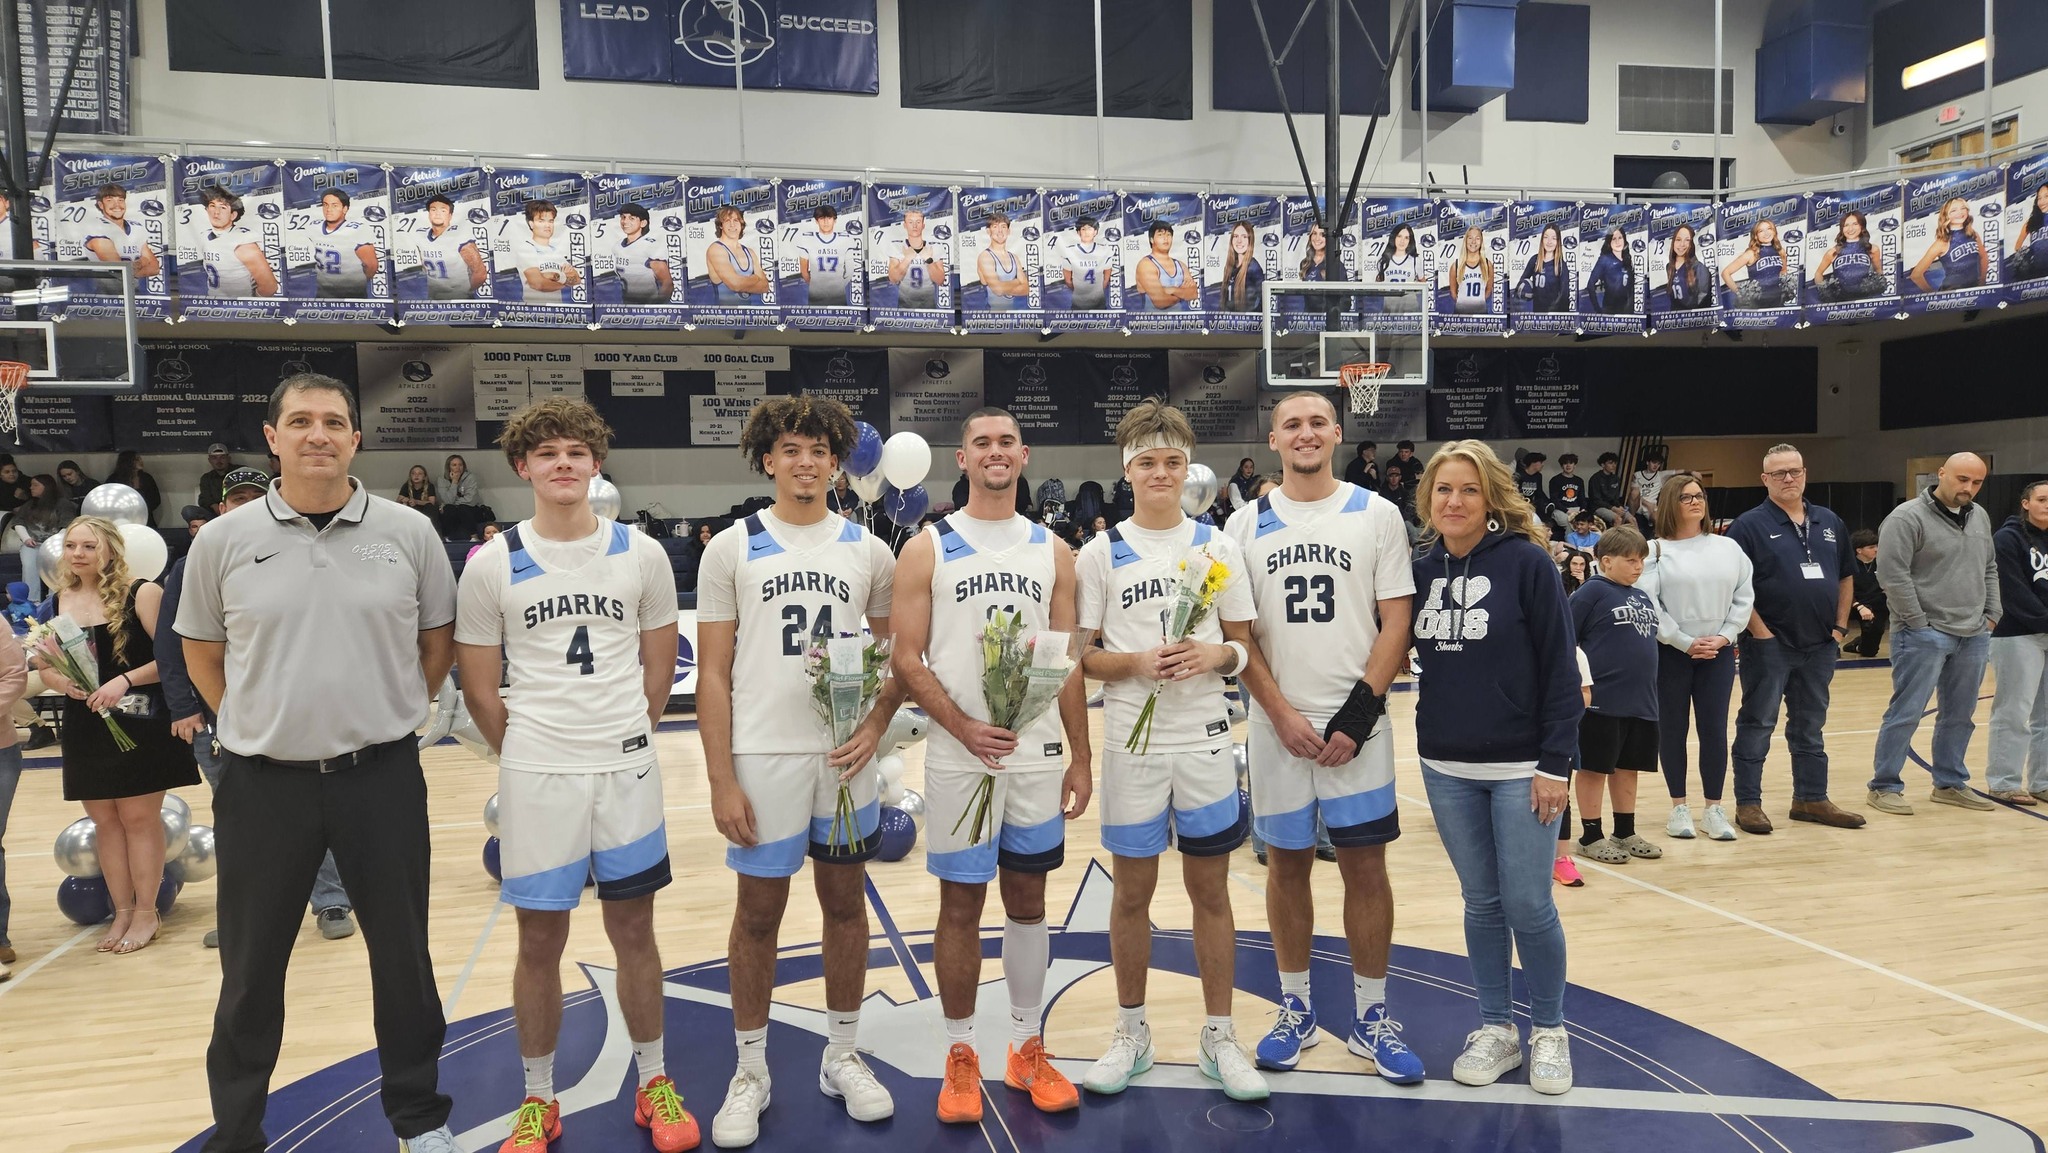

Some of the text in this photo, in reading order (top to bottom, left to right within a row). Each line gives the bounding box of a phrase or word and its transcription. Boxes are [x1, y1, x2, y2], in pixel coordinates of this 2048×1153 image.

[580, 3, 650, 22] LEAD
[779, 14, 874, 35] SUCCEED
[65, 159, 111, 172] Mason
[186, 161, 225, 176] Dallas
[62, 162, 148, 192] SARGIS
[182, 165, 268, 194] SCOTT
[294, 166, 326, 181] Jason
[402, 169, 442, 185] Adriel
[395, 171, 480, 203] RODRIGUEZ
[495, 175, 529, 189] Kaleb
[599, 178, 631, 192] Stefan
[496, 179, 585, 206] STENGEL
[595, 180, 675, 211] PUTZEYS
[688, 184, 724, 199] Chase
[787, 182, 825, 198] Jackson
[878, 187, 909, 200] Chuck
[1910, 170, 1998, 212] RICHARDSON
[688, 185, 771, 214] WILLIAMS
[785, 186, 852, 213] SABATH
[889, 193, 931, 213] SIPE
[960, 194, 988, 206] Ben
[1050, 194, 1080, 206] Kevin
[1126, 196, 1171, 213] Andrew
[1816, 196, 1840, 209] Ava
[1049, 196, 1115, 221] CISNEROS
[1141, 201, 1180, 223] UPP
[1216, 201, 1271, 225] BERGE
[1584, 207, 1609, 219] Emily
[1723, 198, 1797, 231] CAHOON
[1906, 229, 1927, 239] 2026
[60, 246, 82, 256] 2026
[1809, 240, 1828, 249] 2026
[179, 252, 198, 260] 2026
[289, 252, 311, 261] 2026
[396, 255, 417, 264] 2026
[1833, 254, 1871, 269] OHS
[594, 260, 614, 269] 2026
[781, 262, 800, 272] 2026
[817, 257, 838, 272] 17
[910, 267, 923, 288] 9
[1026, 244, 1041, 309] SHARKS
[1084, 269, 1096, 284] 4
[1493, 253, 1504, 313] SHARKS
[1535, 275, 1545, 287] 10
[1466, 282, 1481, 297] 10
[1672, 285, 1683, 299] 13
[1965, 289, 1996, 298] SCHOOL
[1926, 297, 1978, 311] DANCE
[183, 307, 288, 321] FOOTBALL
[294, 308, 392, 321] FOOTBALL
[402, 311, 498, 322] FOOTBALL
[499, 312, 589, 324] BASKETBALL
[599, 315, 687, 325] FOOTBALL
[693, 315, 779, 326] WRESTLING
[1827, 308, 1877, 321] DANCE
[784, 316, 866, 327] FOOTBALL
[874, 318, 952, 329] FOOTBALL
[965, 320, 1043, 329] WRESTLING
[1050, 320, 1123, 329] FOOTBALL
[1128, 321, 1204, 331] WRESTLING
[1515, 321, 1577, 330] VOLLEYBALL
[1580, 322, 1643, 333] VOLLEYBALL
[1733, 317, 1779, 327] DANCE
[483, 352, 571, 362] 1000 POINT CLUB
[594, 352, 678, 363] 1000 YARD CLUB
[703, 354, 774, 363] 100 GOAL CLUB
[141, 393, 183, 402] REGIONAL
[185, 393, 235, 401] QUALIFIERS
[242, 394, 268, 403] 2022
[702, 398, 750, 407] 100 WINS
[1266, 544, 1352, 575] SHARKS
[762, 571, 850, 603] SHARKS
[956, 572, 1042, 603] SHARKS
[1424, 577, 1447, 609] I
[1284, 575, 1335, 623] 23
[524, 594, 624, 629] SHARKS
[782, 605, 834, 656] 24
[1414, 608, 1489, 639] OHS
[566, 625, 594, 675] 4
[1435, 641, 1463, 652] Sharks
